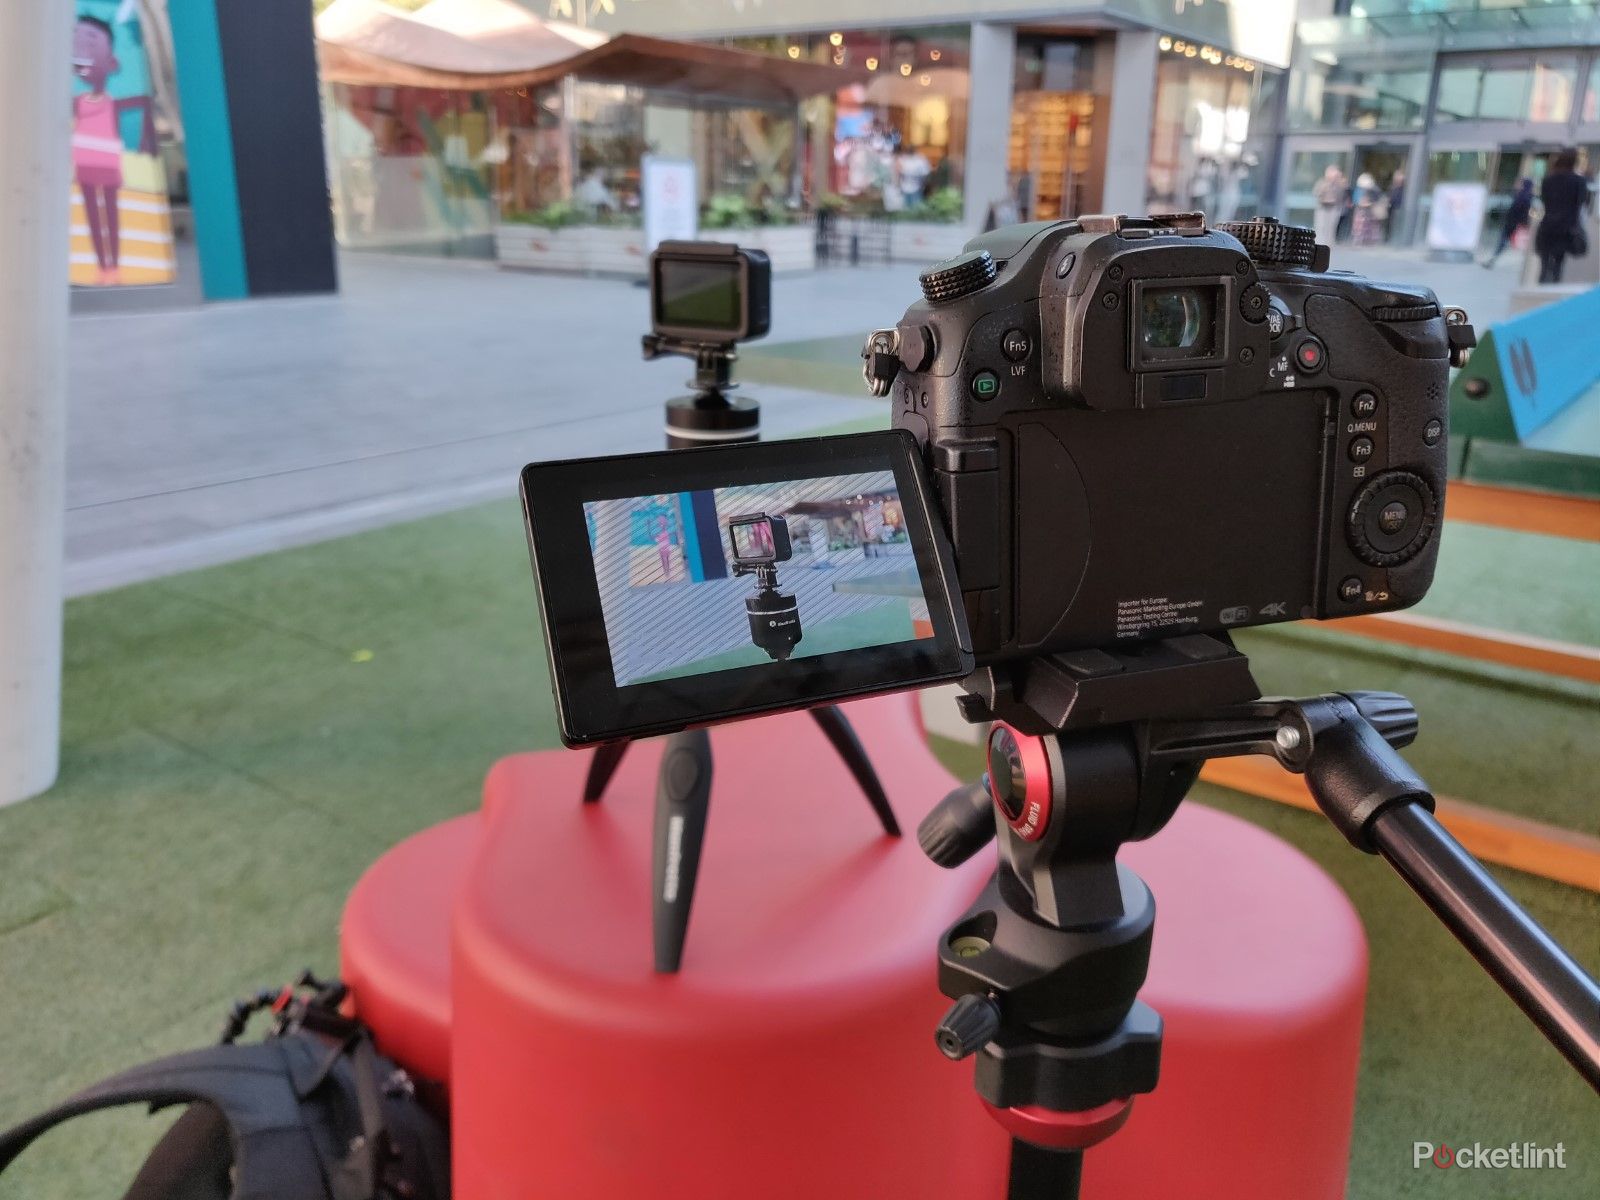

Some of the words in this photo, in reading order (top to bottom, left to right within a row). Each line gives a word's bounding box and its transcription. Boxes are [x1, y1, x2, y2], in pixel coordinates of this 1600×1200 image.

[1009, 341, 1027, 352] Fn5
[1011, 365, 1026, 376] LVF
[1358, 400, 1374, 411] Fn2
[1356, 445, 1371, 456] Fn3
[1117, 607, 1142, 615] Panasonic
[1117, 614, 1142, 623] Panasonic
[1028, 801, 1040, 826] FLUID
